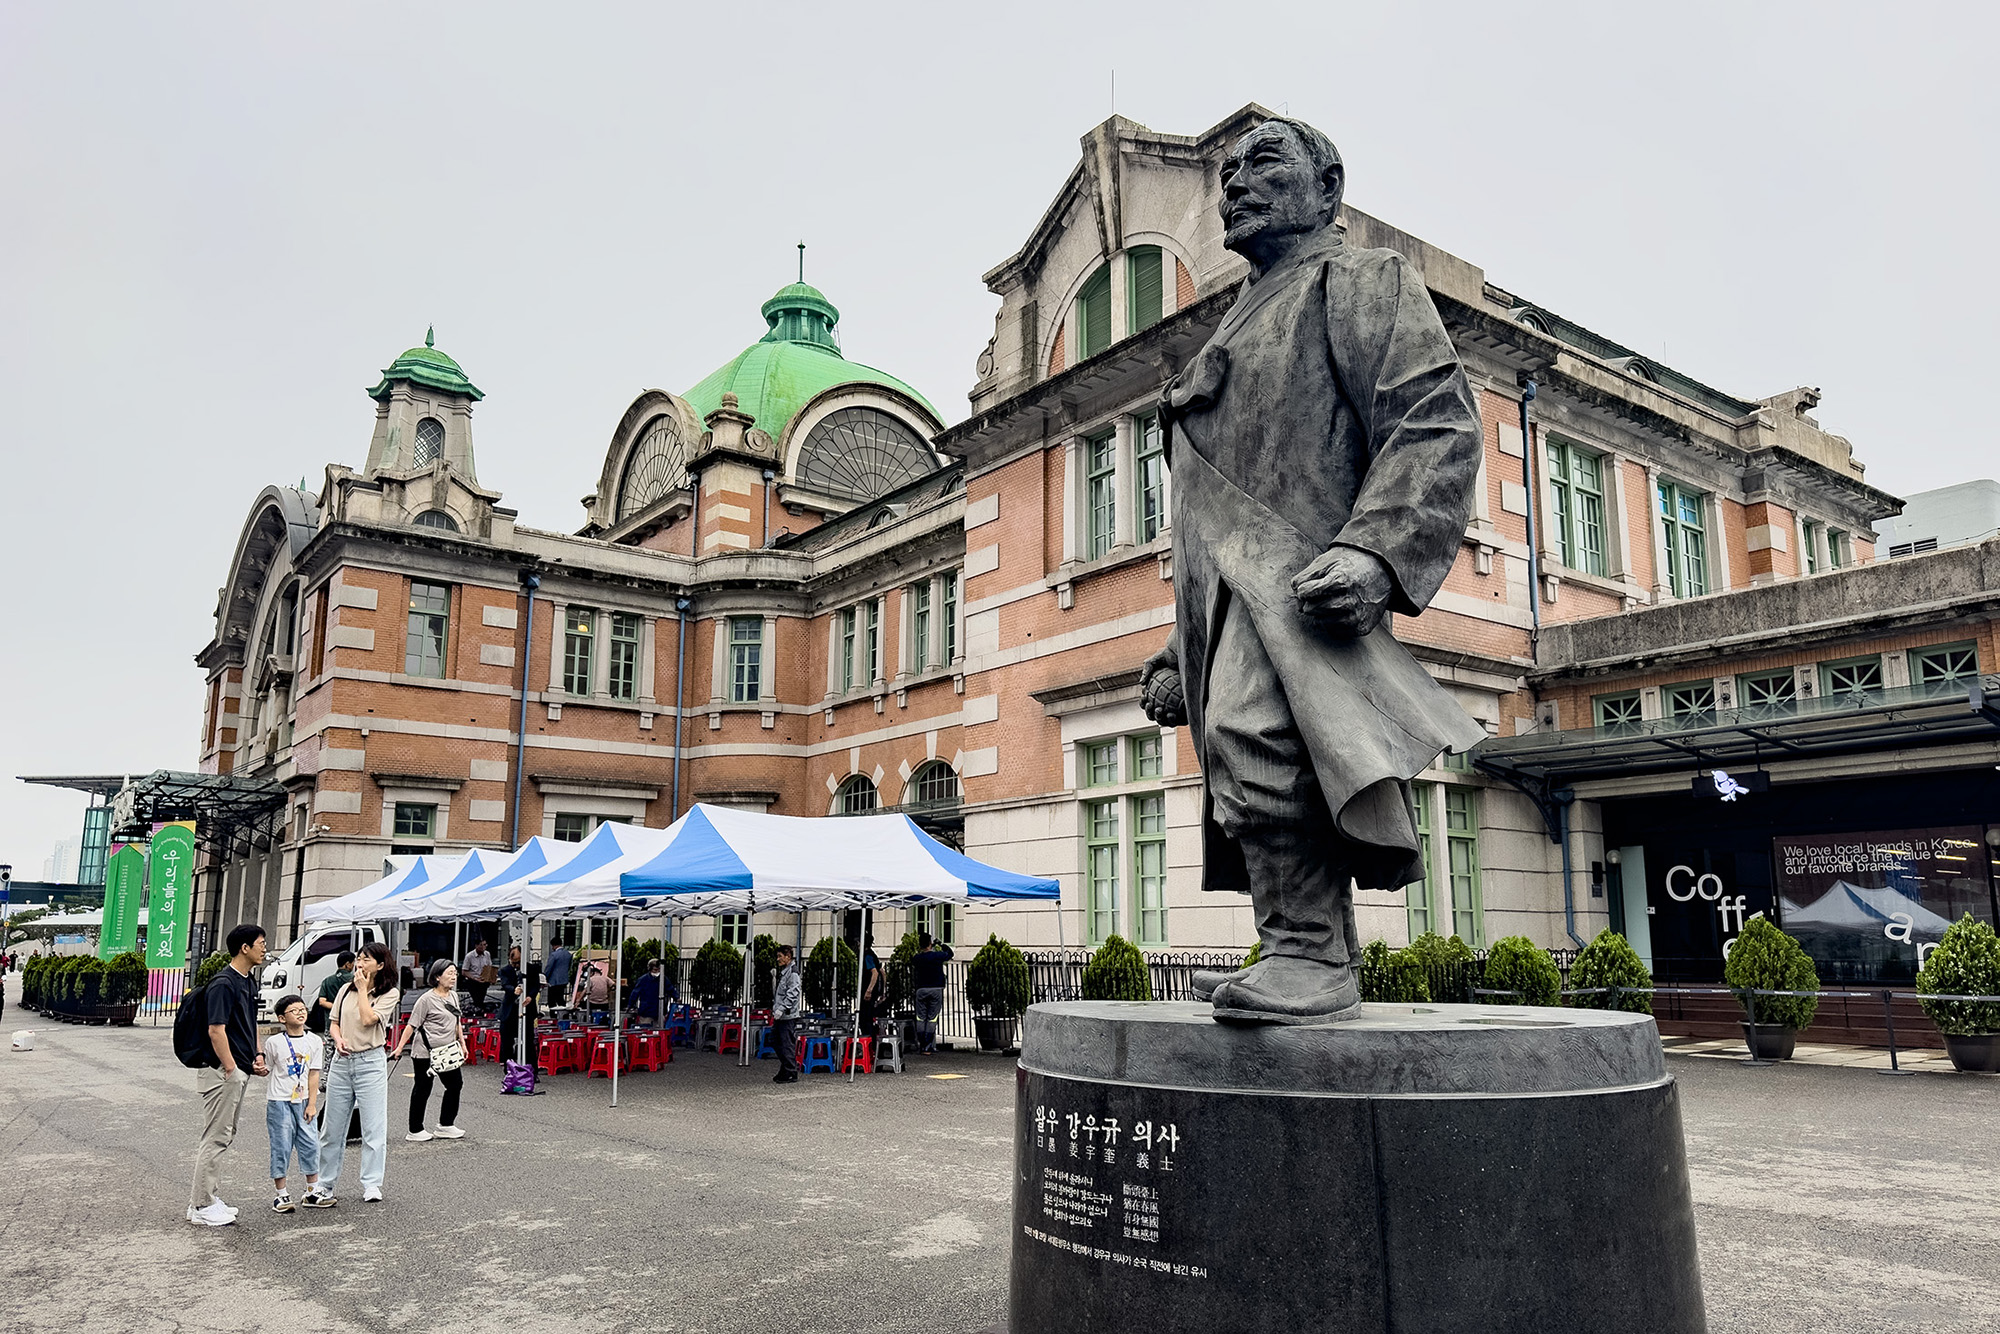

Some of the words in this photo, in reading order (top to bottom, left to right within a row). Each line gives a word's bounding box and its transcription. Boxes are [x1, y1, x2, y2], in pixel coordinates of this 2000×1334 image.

[1783, 845, 1803, 857] We
[1806, 843, 1832, 856] love
[1834, 842, 1864, 854] local
[1867, 840, 1912, 853] brands
[1915, 839, 1928, 850] in
[1785, 854, 1808, 866] and
[1811, 851, 1869, 865] introduce
[1871, 850, 1892, 862] the
[1896, 848, 1931, 861] value
[1935, 848, 1948, 860] of
[1785, 865, 1806, 875] our
[1807, 861, 1854, 874] favorite
[1065, 1112, 1122, 1145] 강우규
[1132, 1120, 1180, 1153] 의사
[1093, 1248, 1111, 1261] 강우규
[1112, 1252, 1132, 1266] 의사가
[1132, 1257, 1148, 1269] 순국
[1149, 1259, 1172, 1273] 직전에
[1173, 1264, 1189, 1276] 남긴
[1190, 1266, 1208, 1279] 유시
